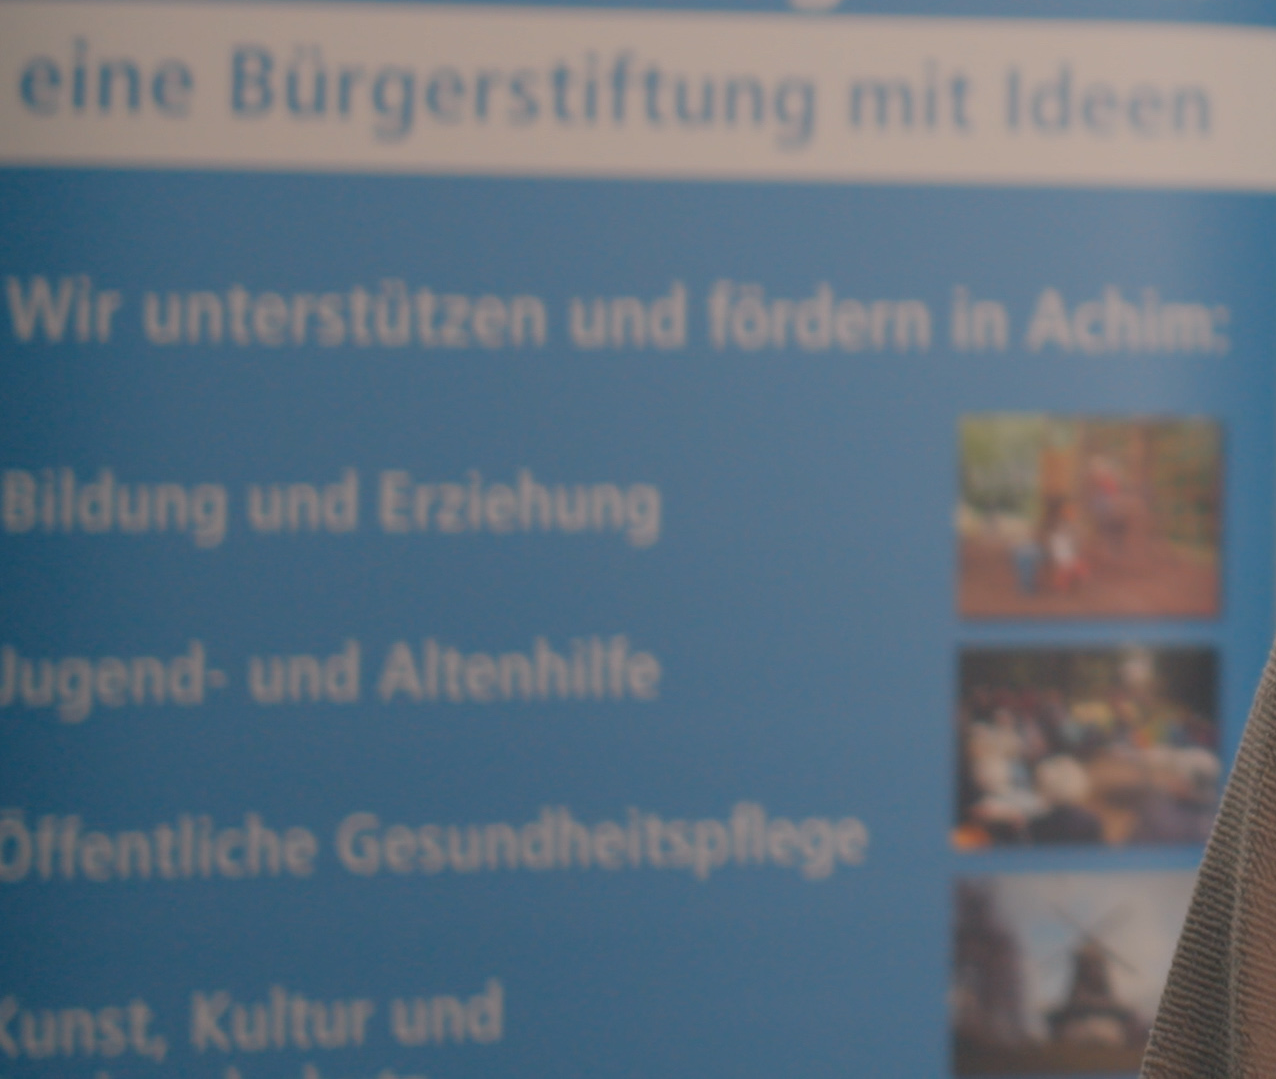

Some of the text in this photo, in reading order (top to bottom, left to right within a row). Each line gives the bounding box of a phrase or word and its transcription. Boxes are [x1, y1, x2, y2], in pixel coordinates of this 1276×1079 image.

[17, 38, 1212, 151] eine Bürgerstiftung mit Ideen
[6, 274, 1231, 355] Wir unterstützen und fördern in Achim:
[2, 467, 662, 549] Bildung und Erziehung
[0, 634, 662, 724] Jugend- und Altenhilfe
[336, 803, 869, 879] Gesundheitspflege
[190, 985, 375, 1051] Kultur
[390, 977, 504, 1043] und
